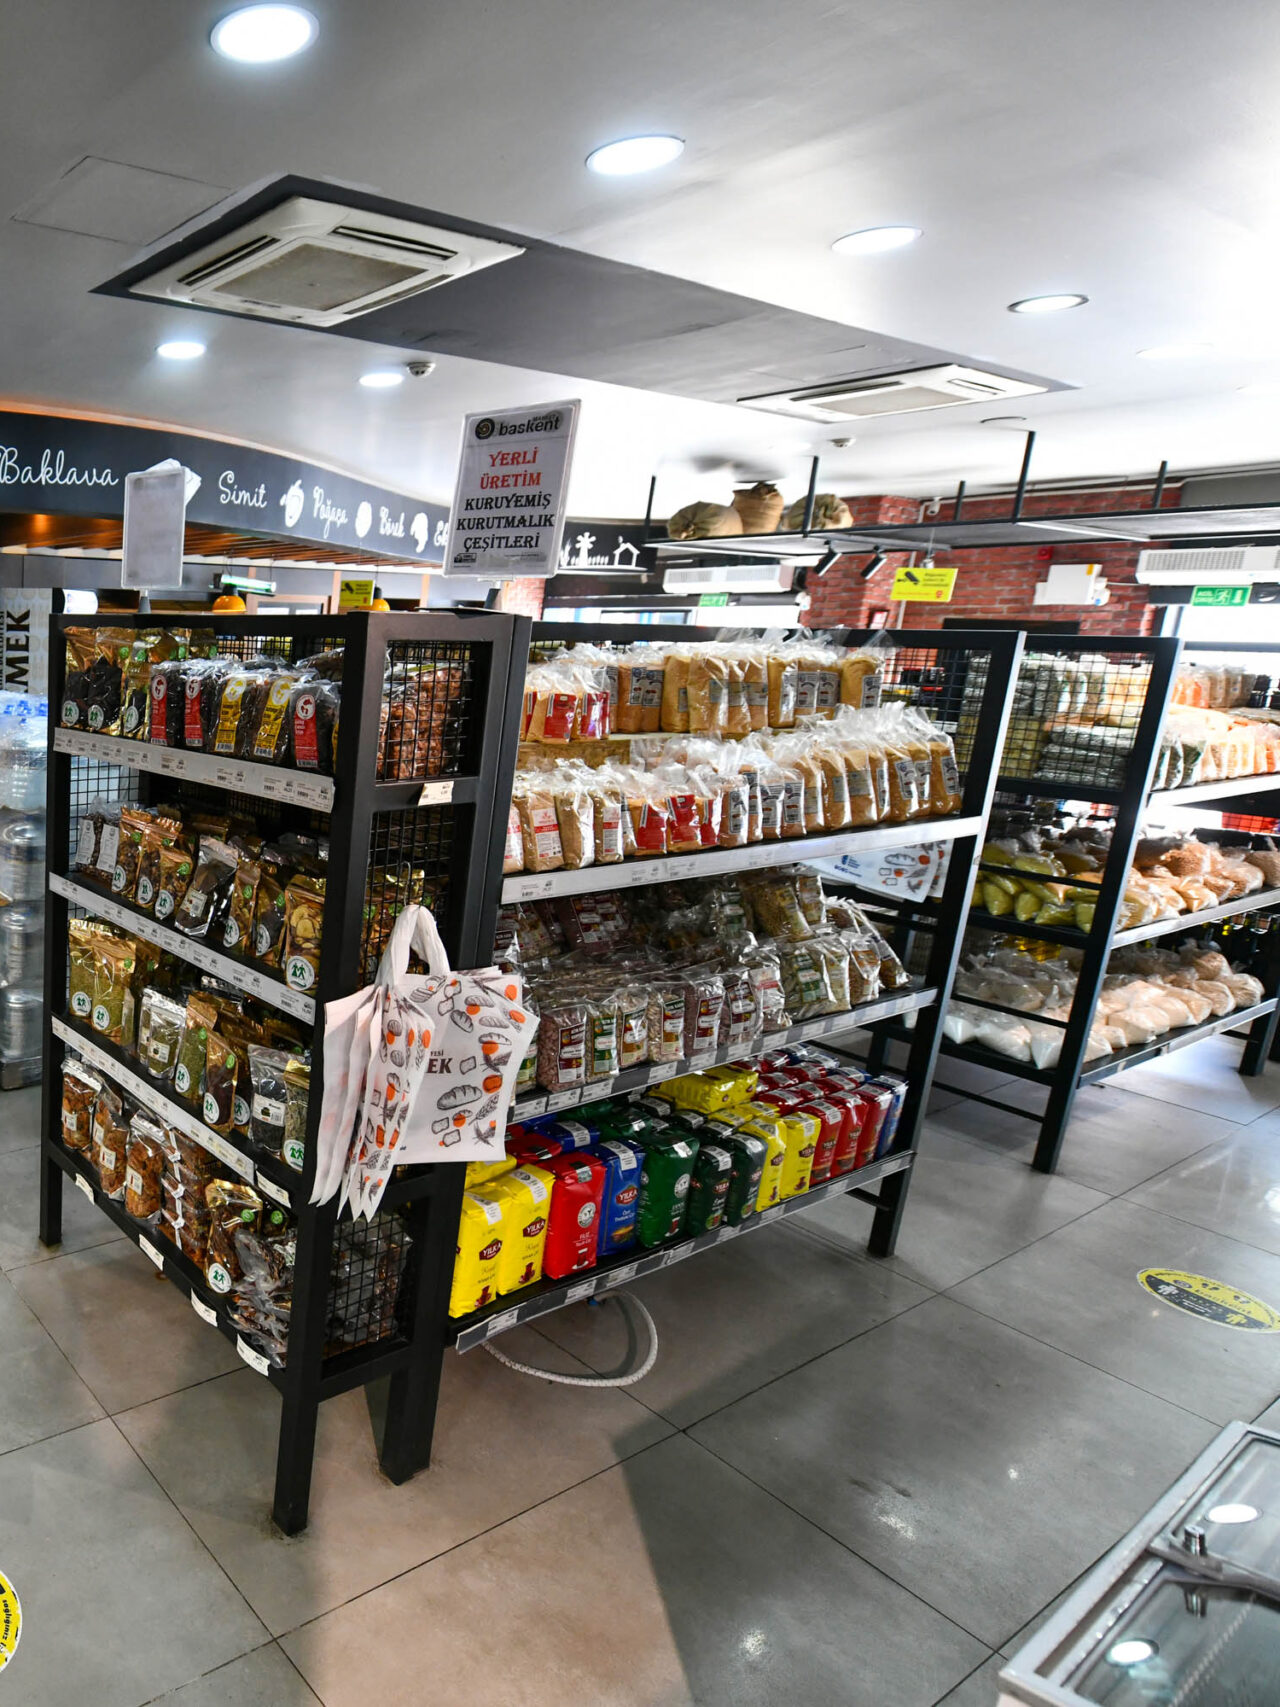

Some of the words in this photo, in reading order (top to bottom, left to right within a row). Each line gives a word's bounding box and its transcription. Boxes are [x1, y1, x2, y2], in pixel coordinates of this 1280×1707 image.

[498, 415, 561, 437] baskent
[489, 447, 539, 468] YERLİ
[218, 470, 268, 509] Simit
[480, 470, 542, 491] ÜRETİM
[464, 491, 553, 512] KURUYEMİŞ
[456, 513, 555, 531] KURUTMALIK
[463, 532, 541, 553] ÇEŞİTLERİ
[5, 609, 31, 693] MEK
